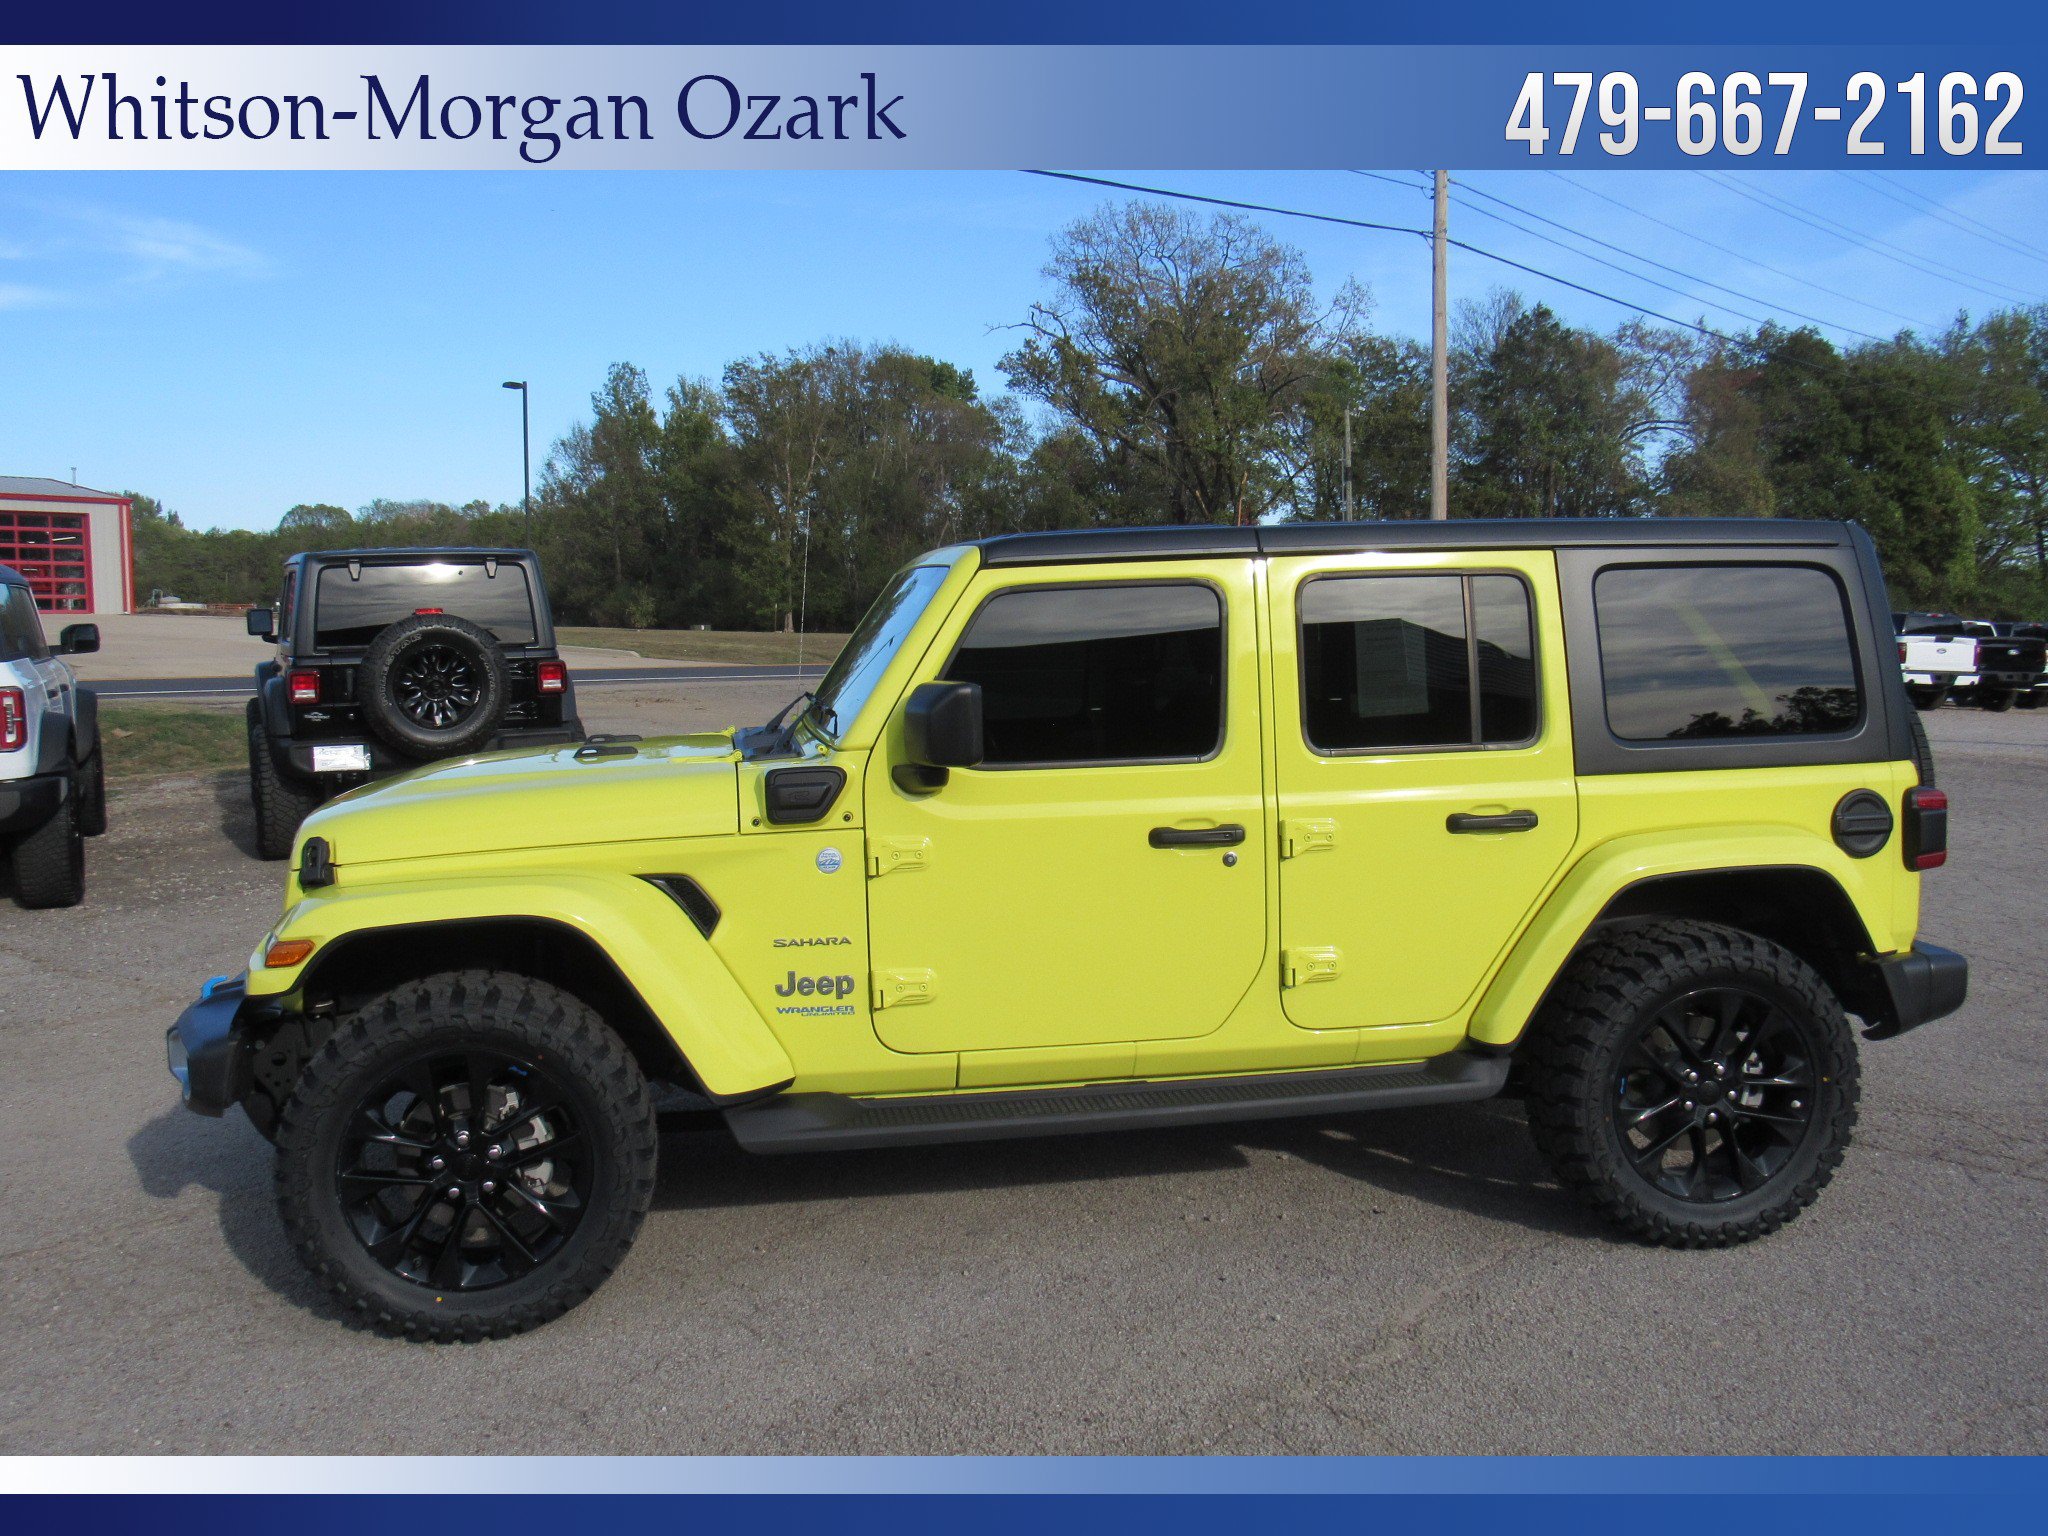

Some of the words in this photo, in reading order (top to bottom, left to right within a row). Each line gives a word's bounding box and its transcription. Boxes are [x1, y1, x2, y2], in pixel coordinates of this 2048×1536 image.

[773, 937, 852, 948] SAHARA
[775, 970, 855, 999] Jeep
[776, 1005, 855, 1014] WRANGLER
